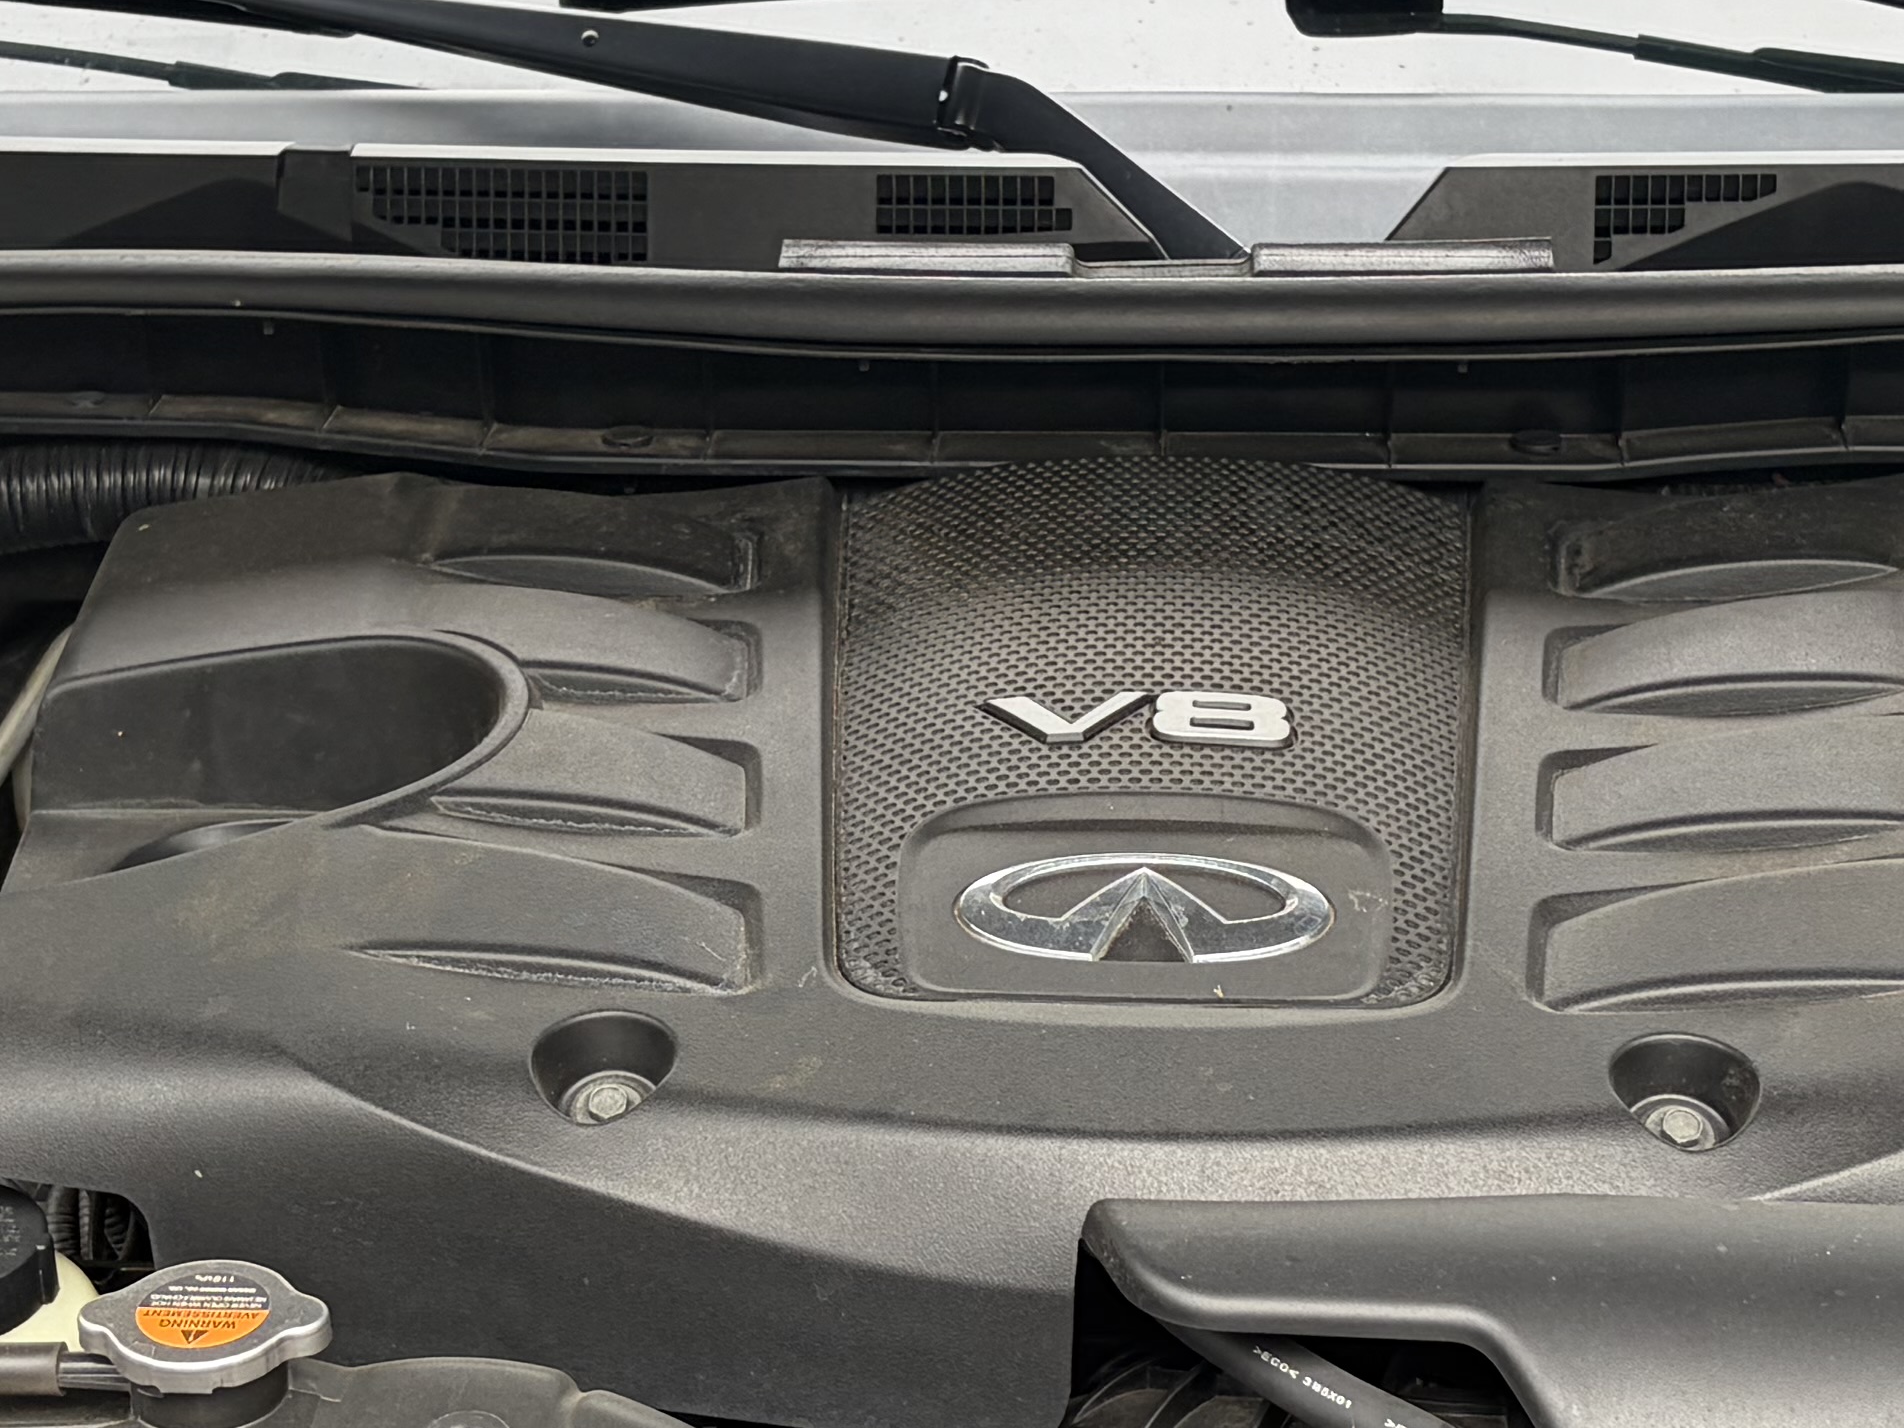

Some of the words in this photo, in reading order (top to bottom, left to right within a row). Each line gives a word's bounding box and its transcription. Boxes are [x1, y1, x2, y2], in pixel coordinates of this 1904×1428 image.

[976, 690, 1295, 749] V8
[143, 1309, 260, 1320] AVERTISSEMENT
[158, 1319, 237, 1330] WARNING
